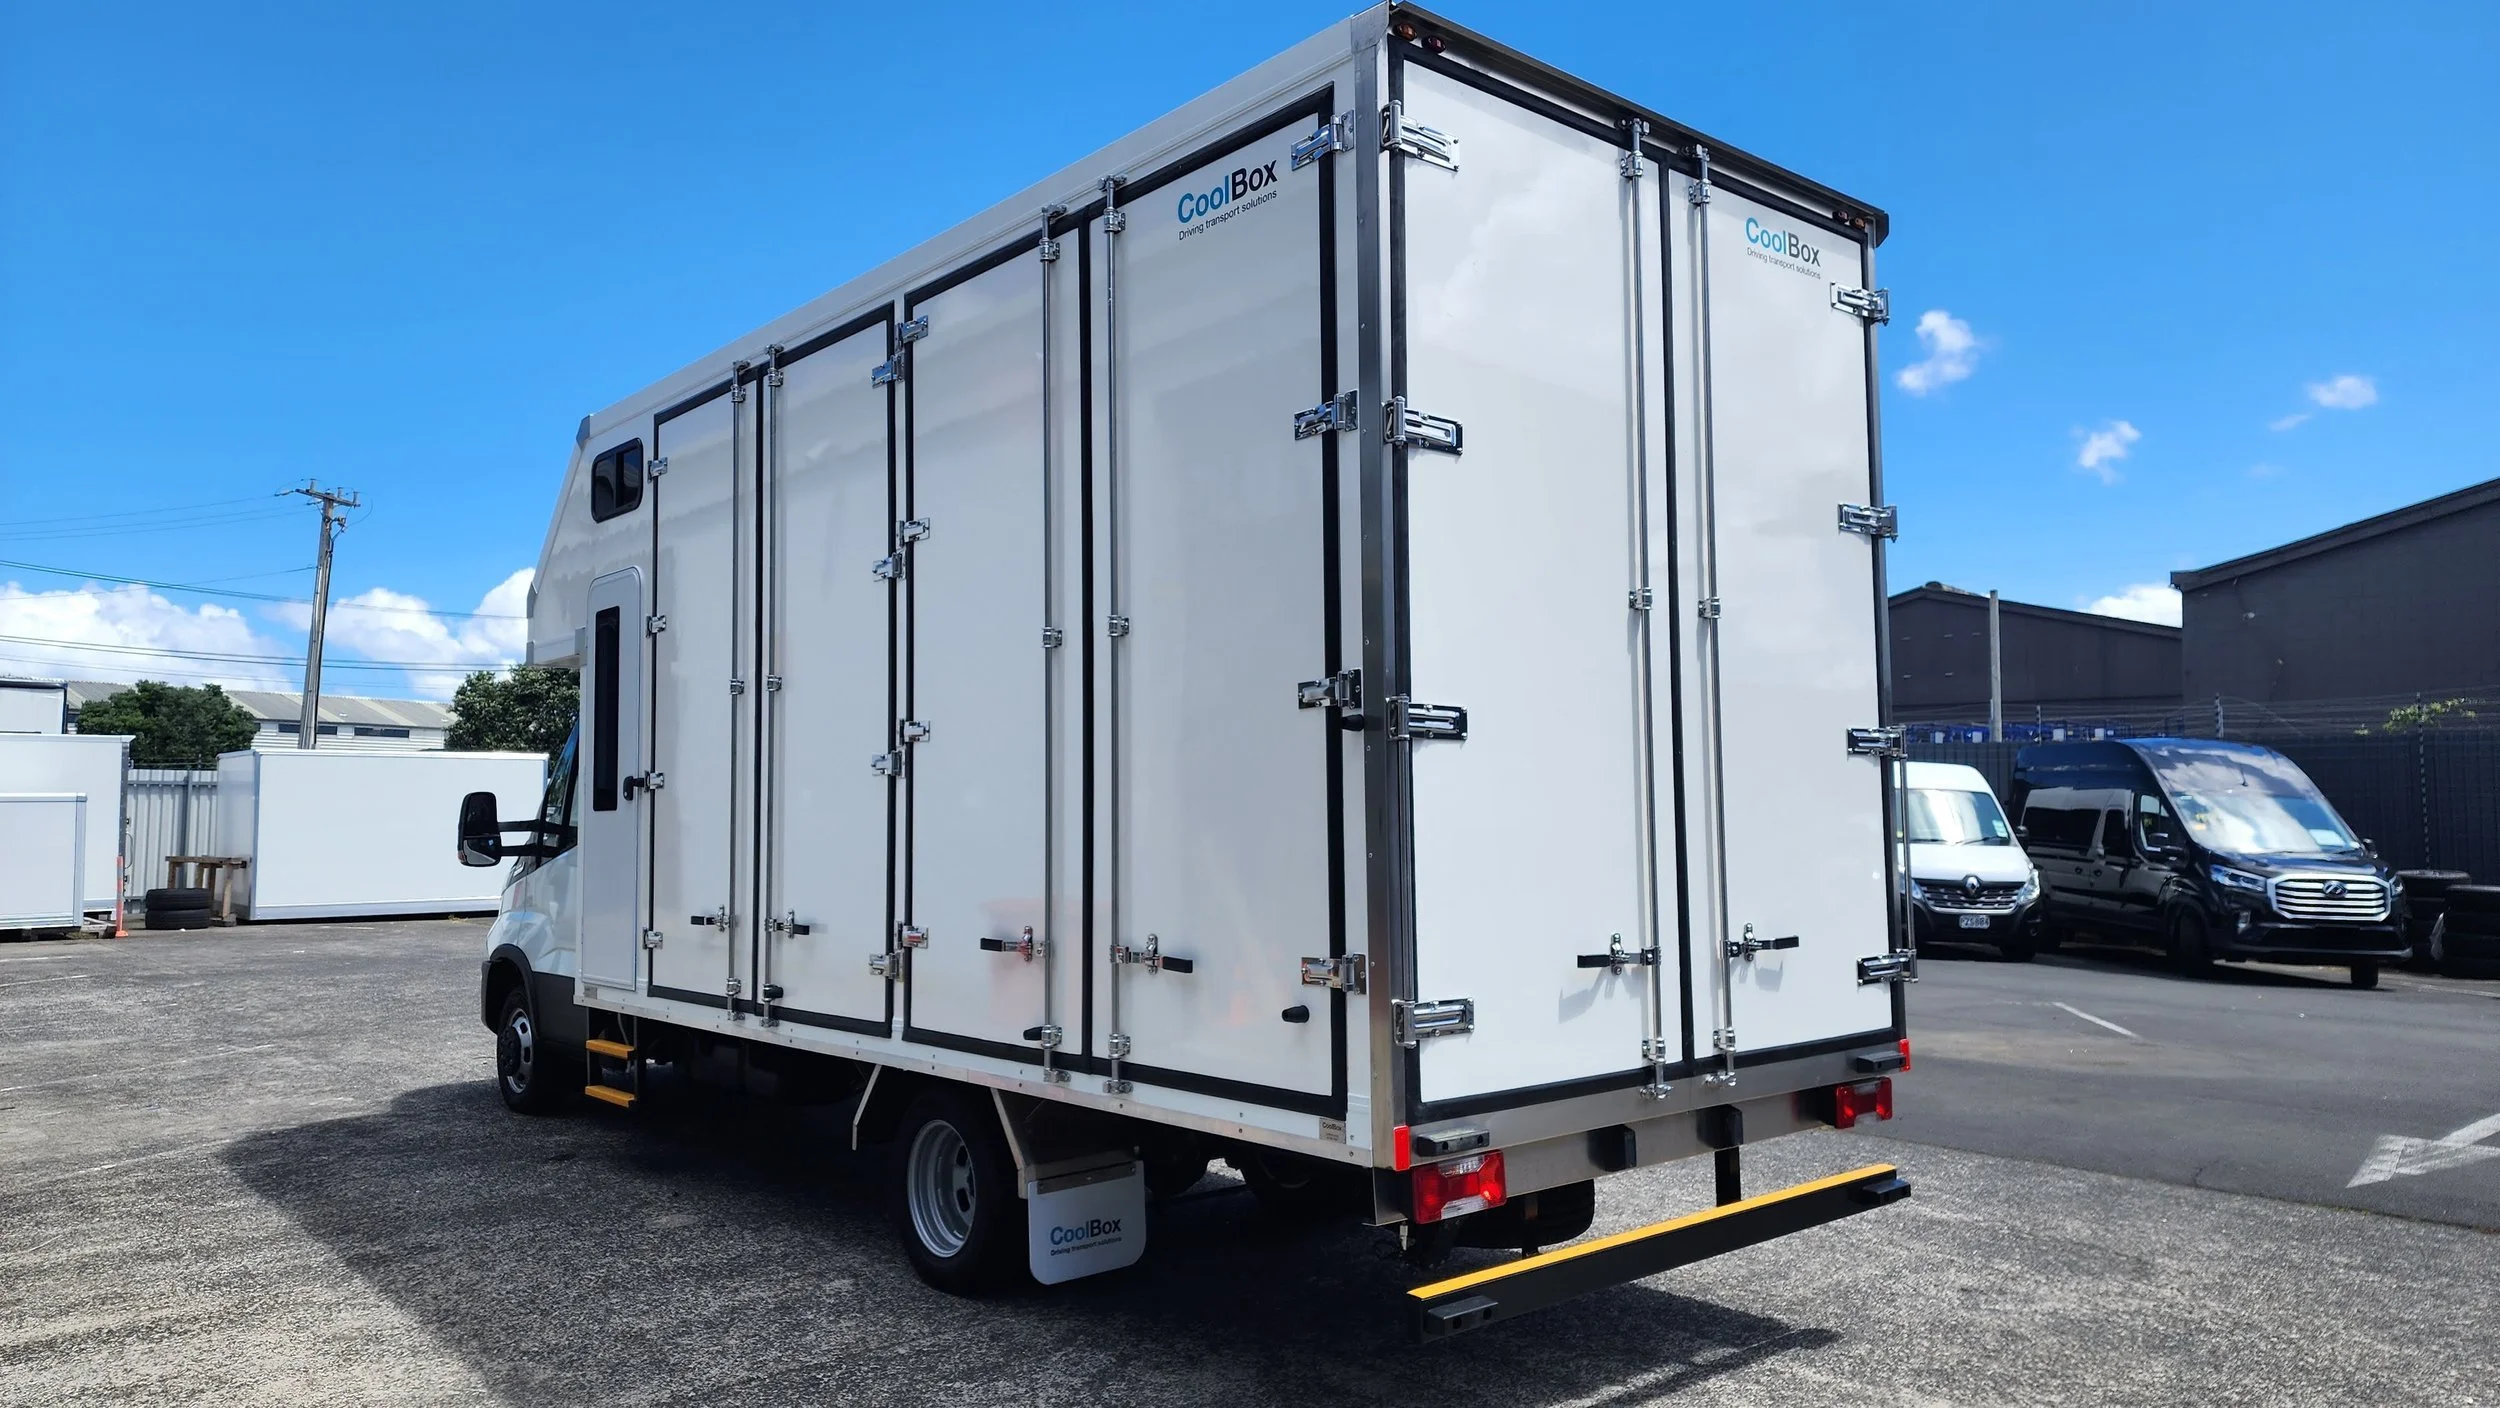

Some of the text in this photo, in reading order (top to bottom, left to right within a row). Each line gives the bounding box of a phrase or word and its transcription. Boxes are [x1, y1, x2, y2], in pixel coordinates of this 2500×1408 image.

[1178, 160, 1278, 223] CoolBox
[1179, 190, 1277, 240] Driving transport solutions
[1745, 217, 1821, 267] CoolBox
[1747, 247, 1821, 280] Driving transport solutions
[1050, 1218, 1121, 1245] CoolBox
